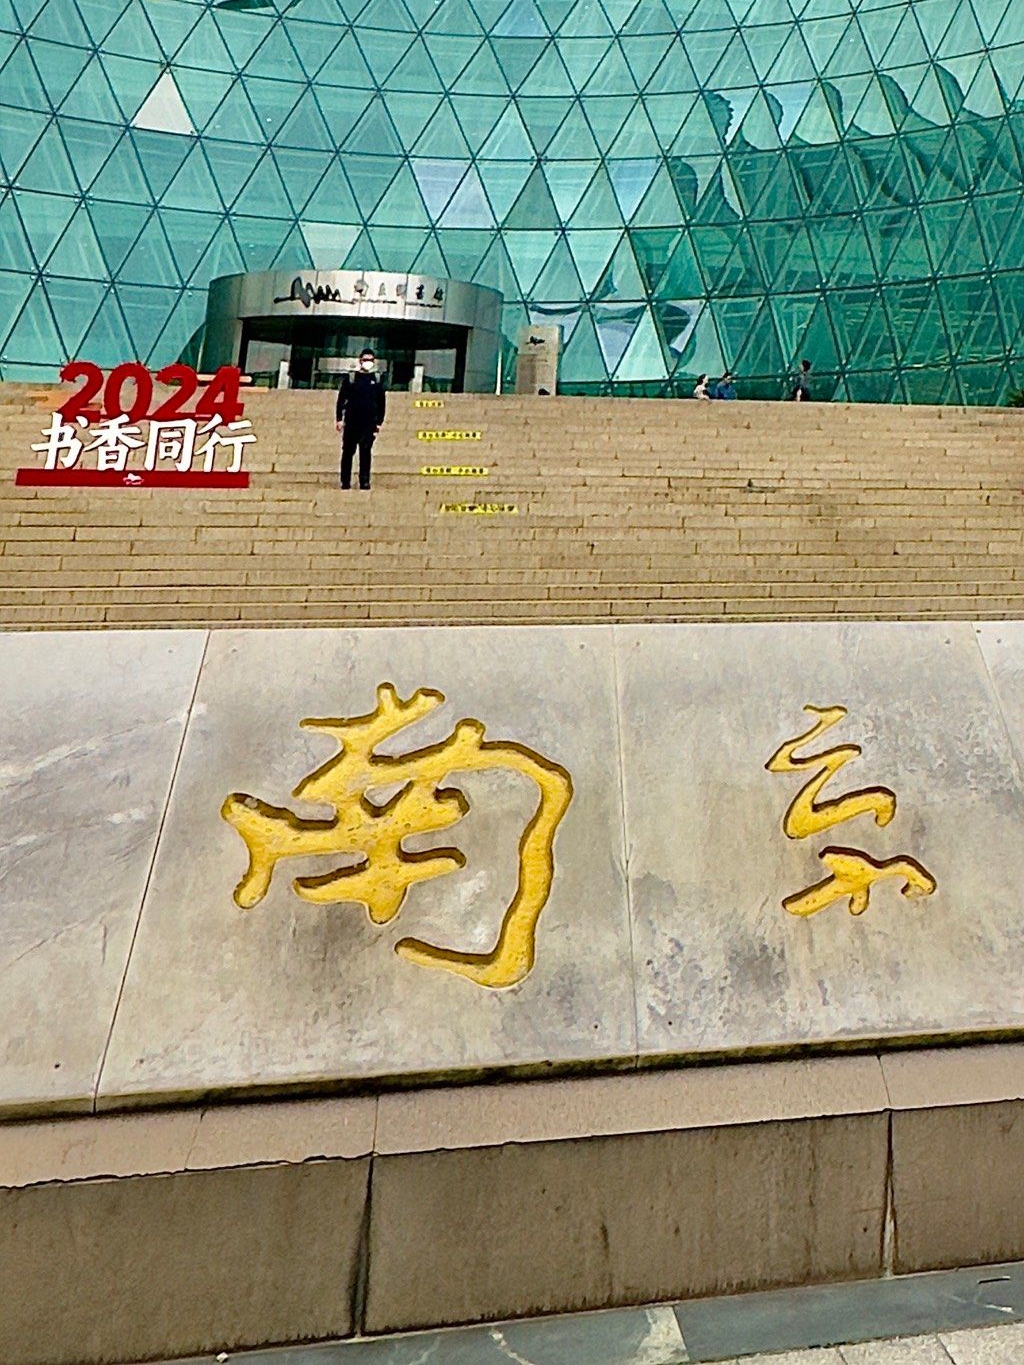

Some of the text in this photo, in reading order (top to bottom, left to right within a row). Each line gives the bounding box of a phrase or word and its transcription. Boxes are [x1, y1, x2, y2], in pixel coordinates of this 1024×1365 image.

[57, 360, 246, 426] 2024
[30, 411, 258, 473] 书香同行
